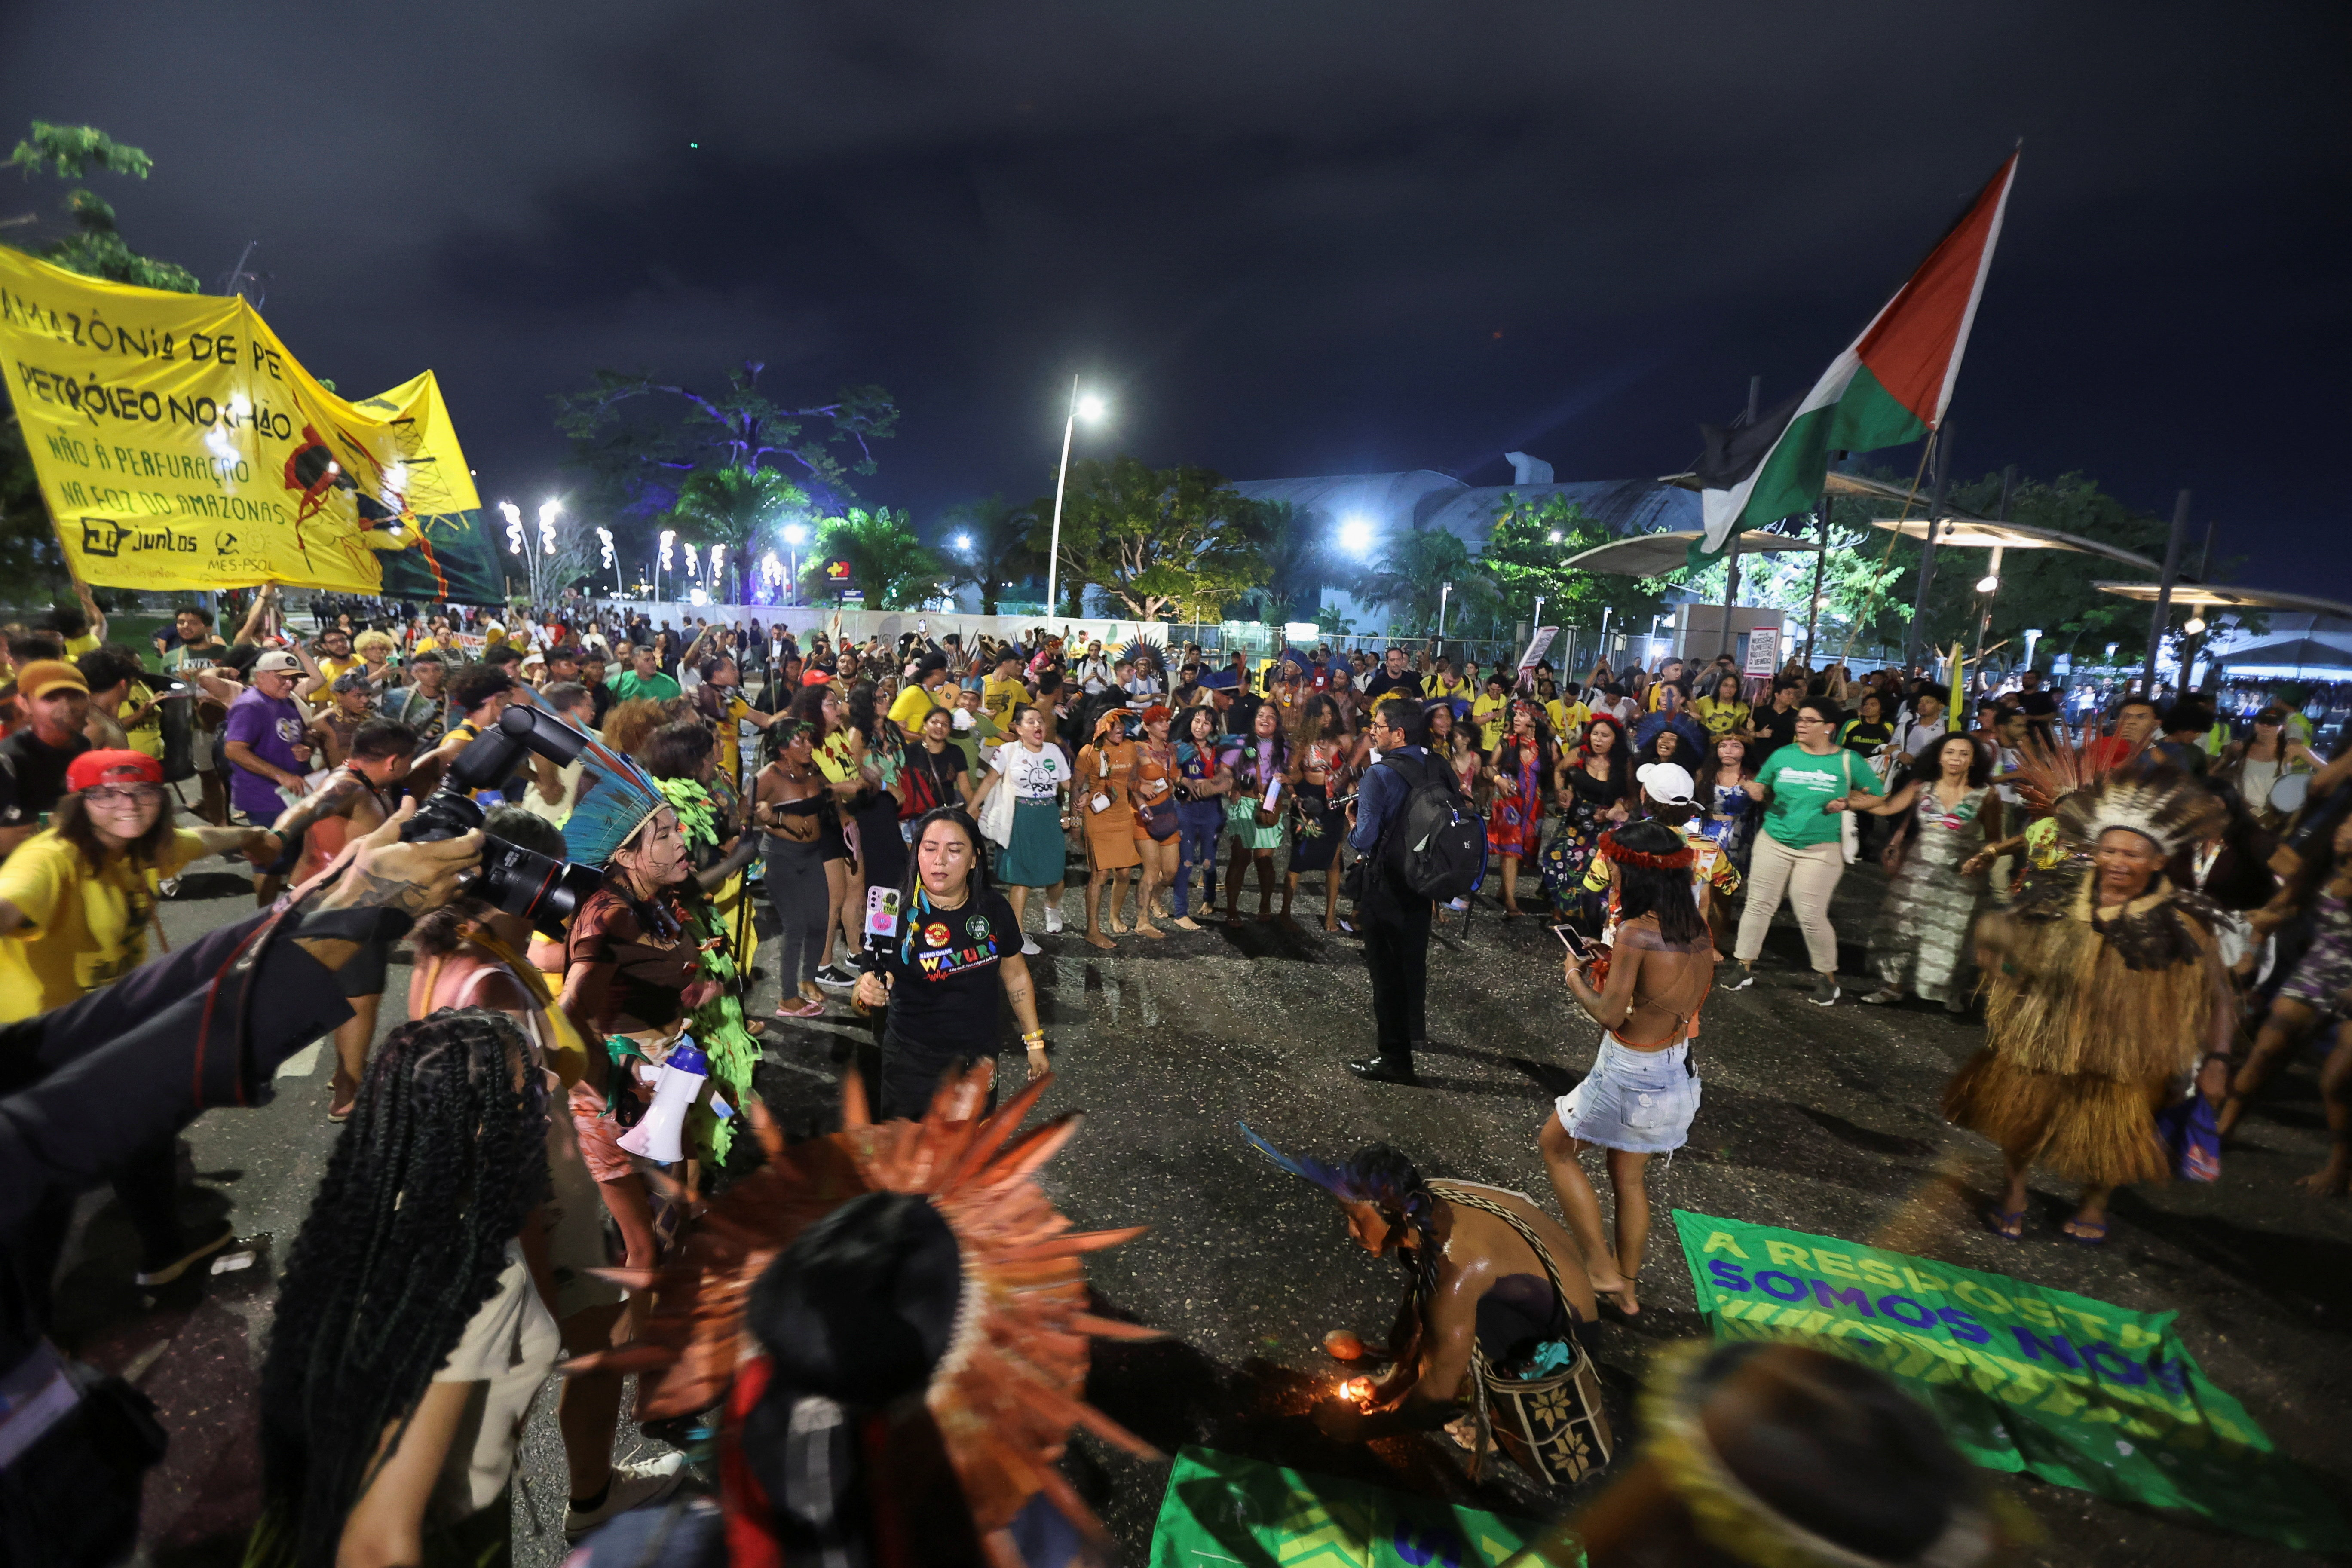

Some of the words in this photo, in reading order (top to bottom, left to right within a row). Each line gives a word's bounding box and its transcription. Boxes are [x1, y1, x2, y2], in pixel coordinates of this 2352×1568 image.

[190, 333, 236, 364] DE
[17, 361, 161, 426] PETRÓLEO
[168, 394, 216, 426] NO
[46, 427, 89, 468] NÃO
[61, 481, 88, 507] NA
[91, 485, 138, 514] FOZ
[139, 491, 172, 515] DO
[177, 494, 285, 525] AMAZONAS
[132, 524, 197, 552] juntos
[208, 558, 275, 572] MES-PSOL
[1703, 1230, 1749, 1260] A
[1709, 1259, 1991, 1345] SOMOS
